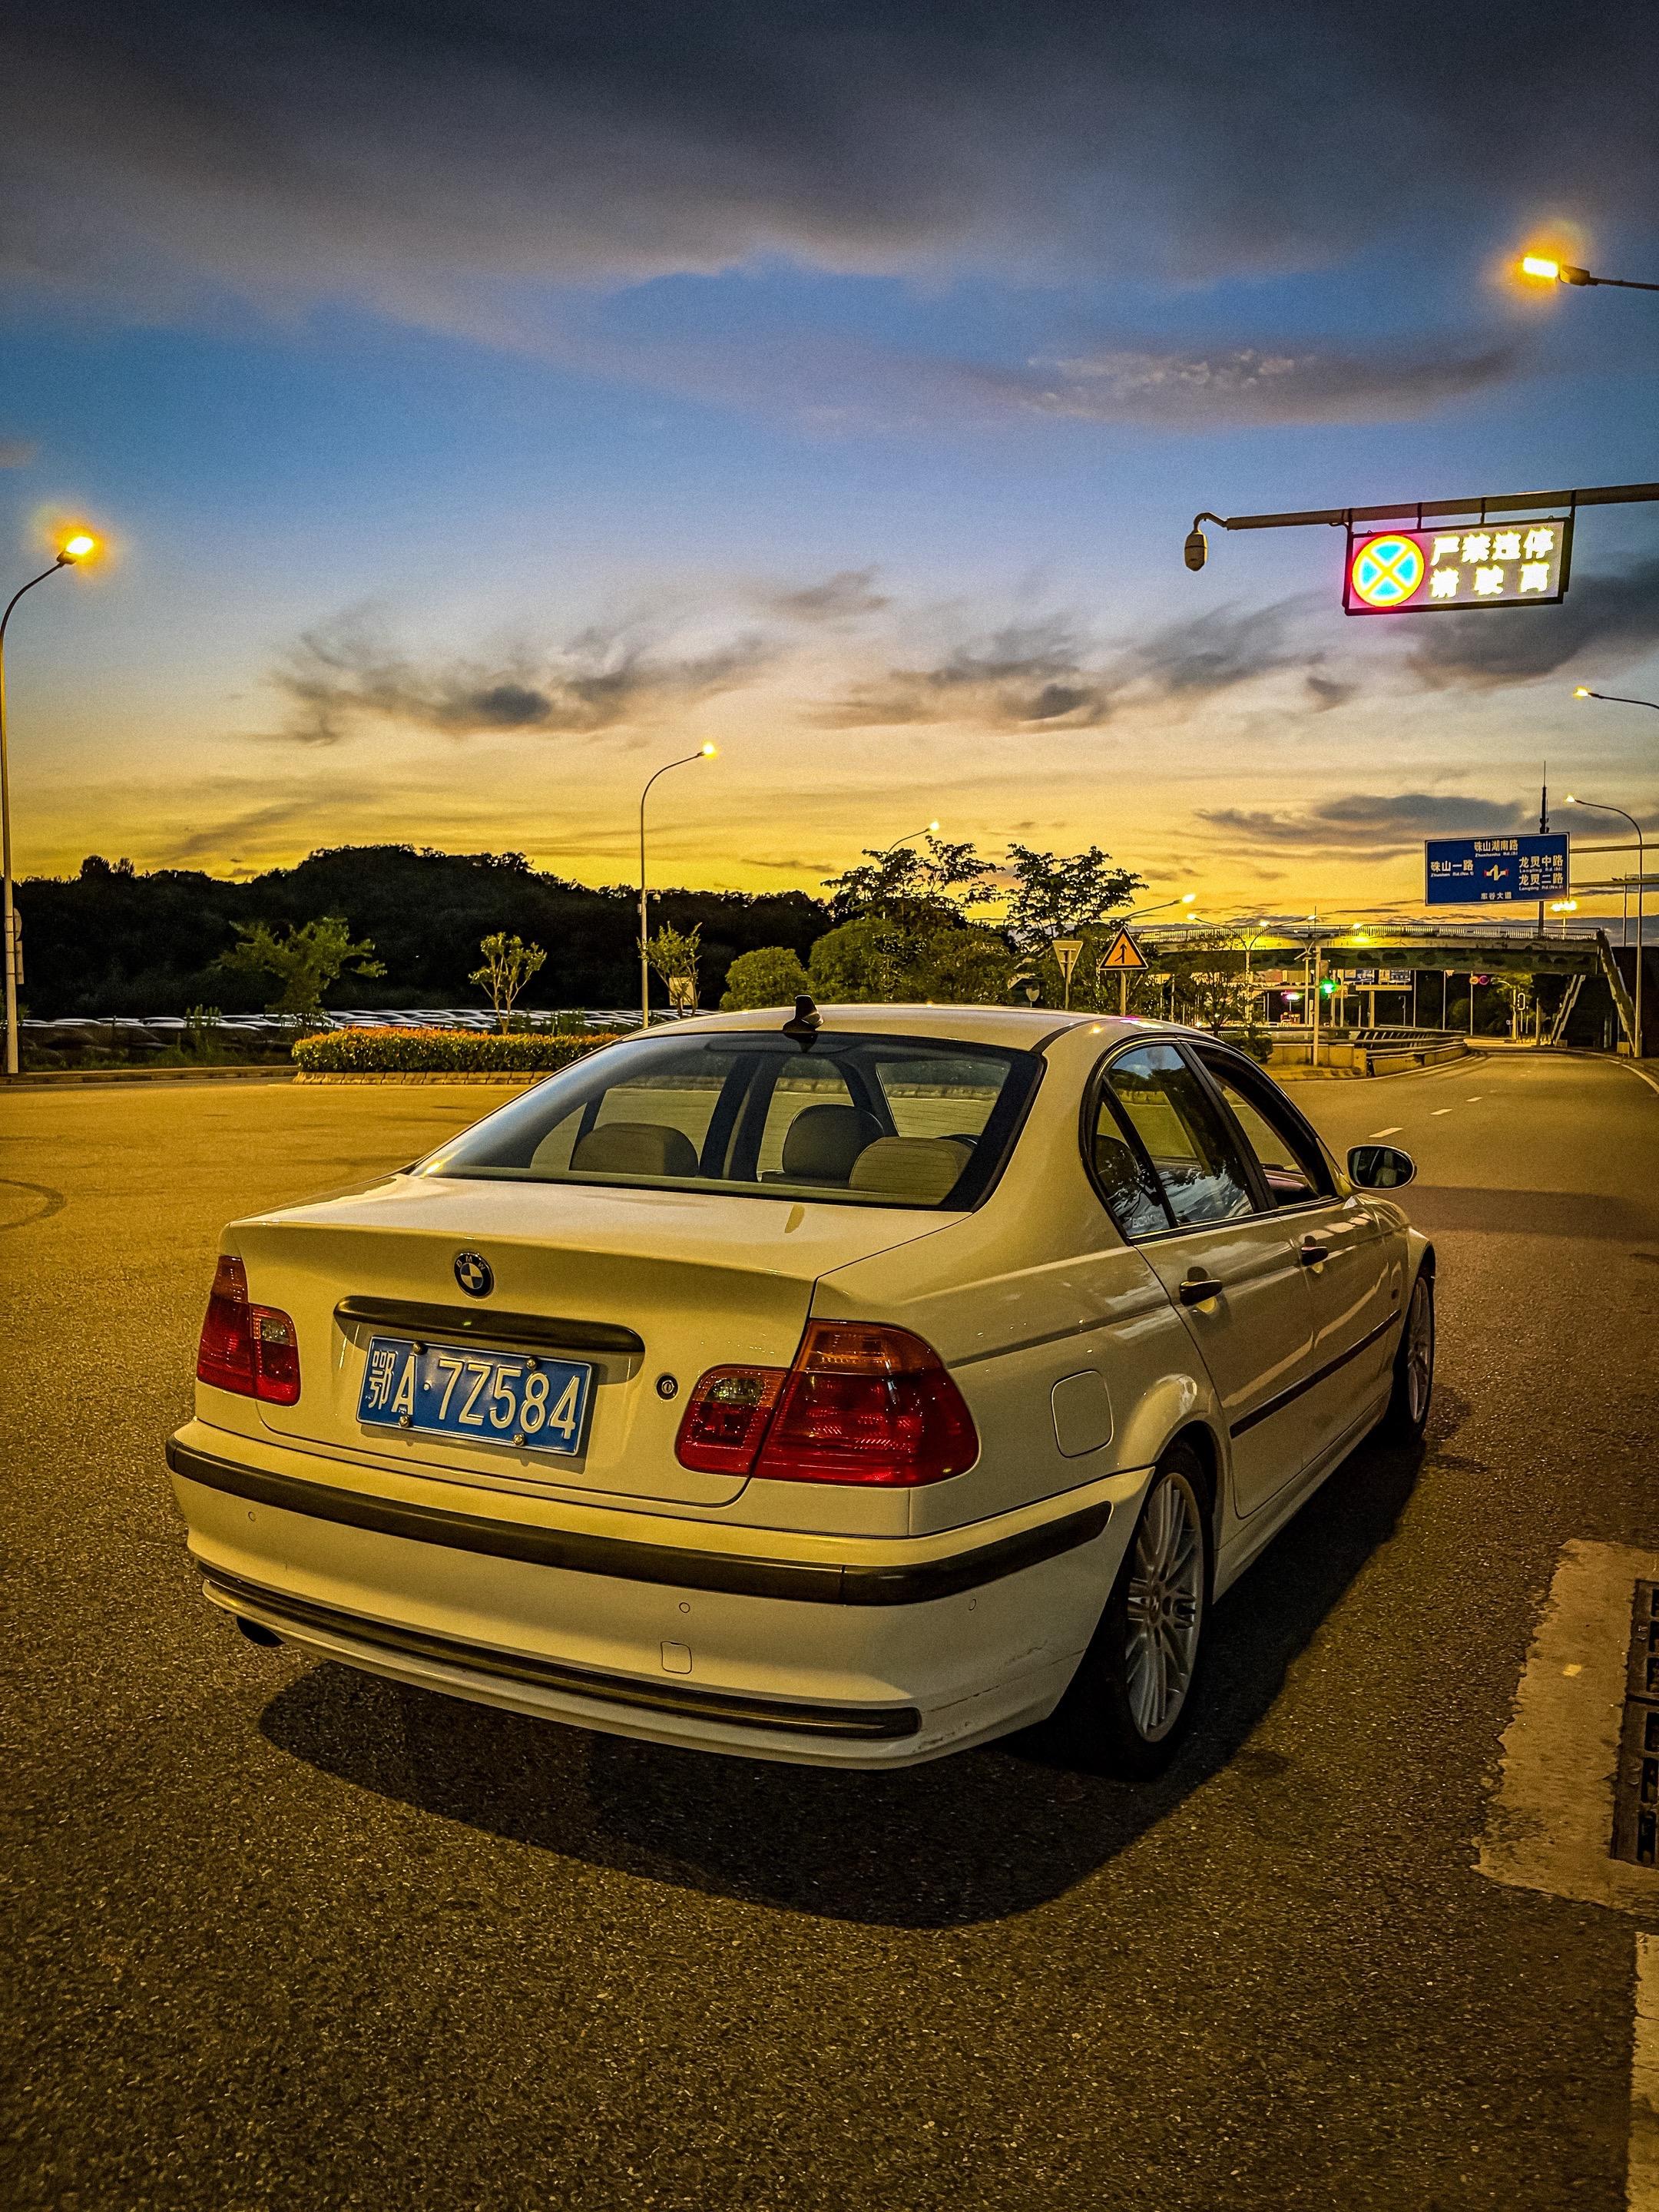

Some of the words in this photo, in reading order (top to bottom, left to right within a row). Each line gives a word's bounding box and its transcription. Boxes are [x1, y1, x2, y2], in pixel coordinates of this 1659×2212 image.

[1430, 526, 1555, 566] 严禁违停
[1518, 854, 1564, 869] 龙灵中路
[1518, 873, 1564, 886] 龙灵二路
[455, 1255, 486, 1270] BMW
